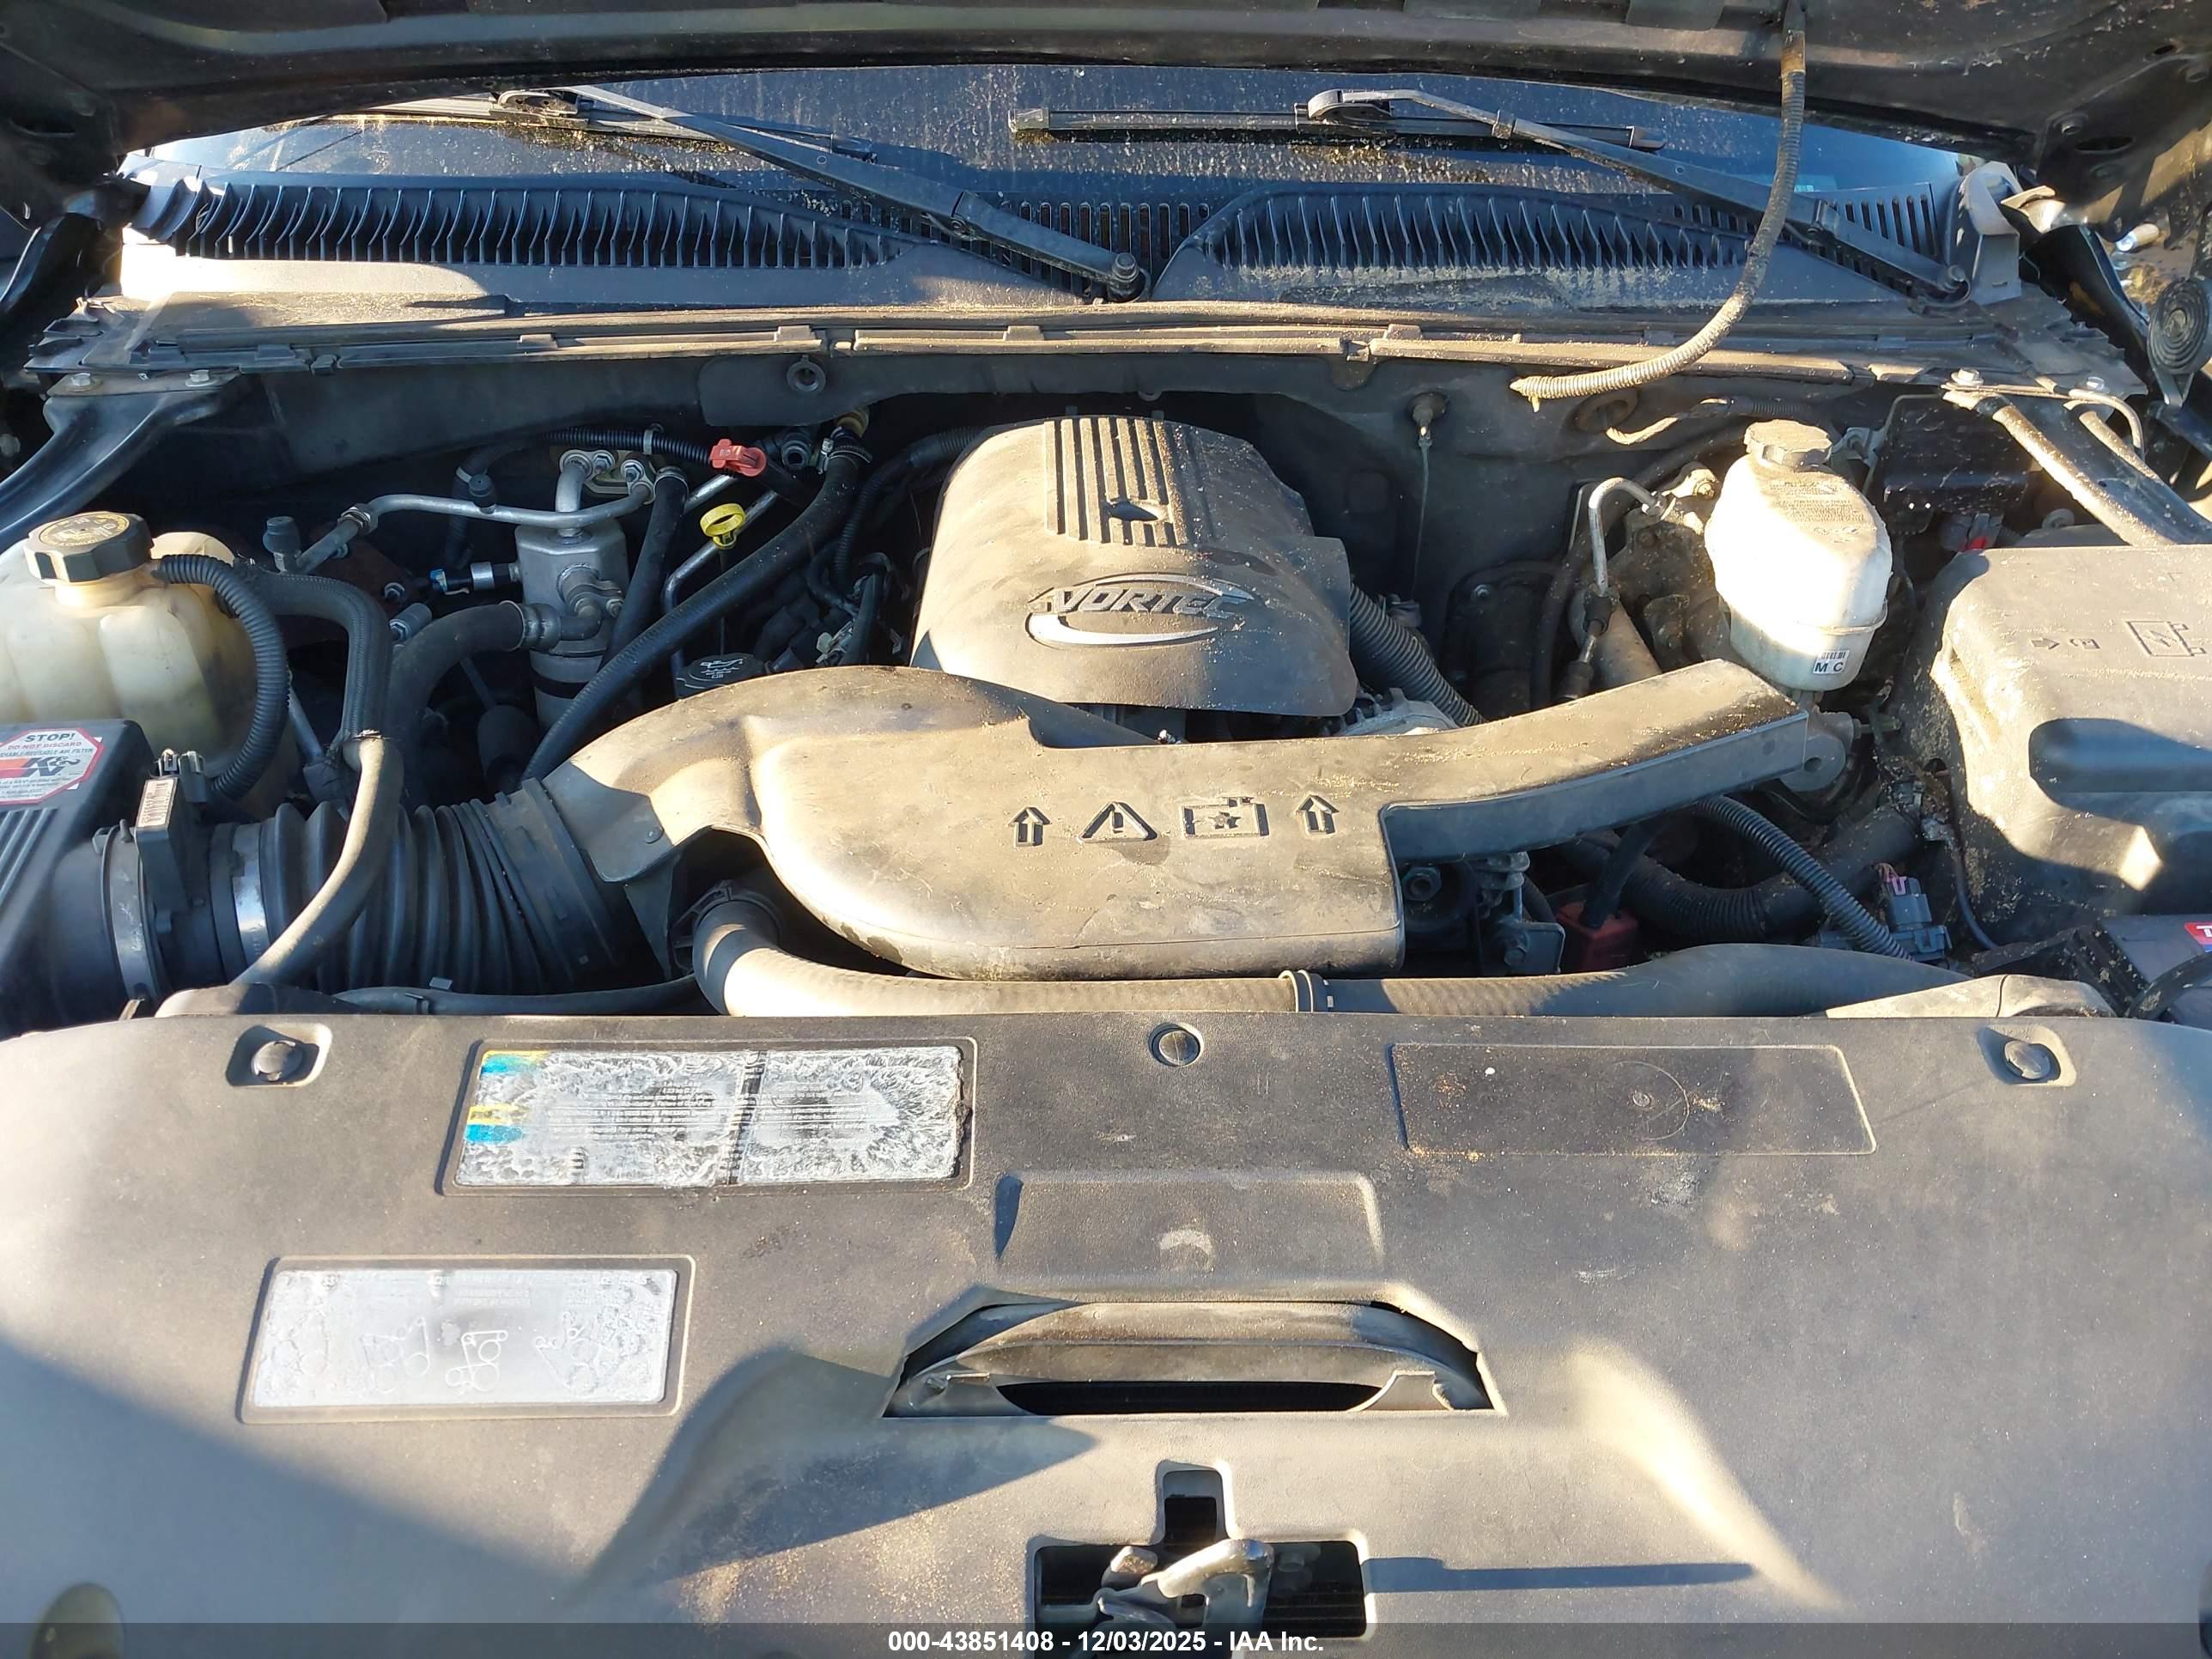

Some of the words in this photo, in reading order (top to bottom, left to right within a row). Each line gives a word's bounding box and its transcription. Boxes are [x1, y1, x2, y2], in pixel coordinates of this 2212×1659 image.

[1814, 662, 1829, 672] M
[1832, 661, 1844, 672] C
[25, 733, 76, 743] STOP!
